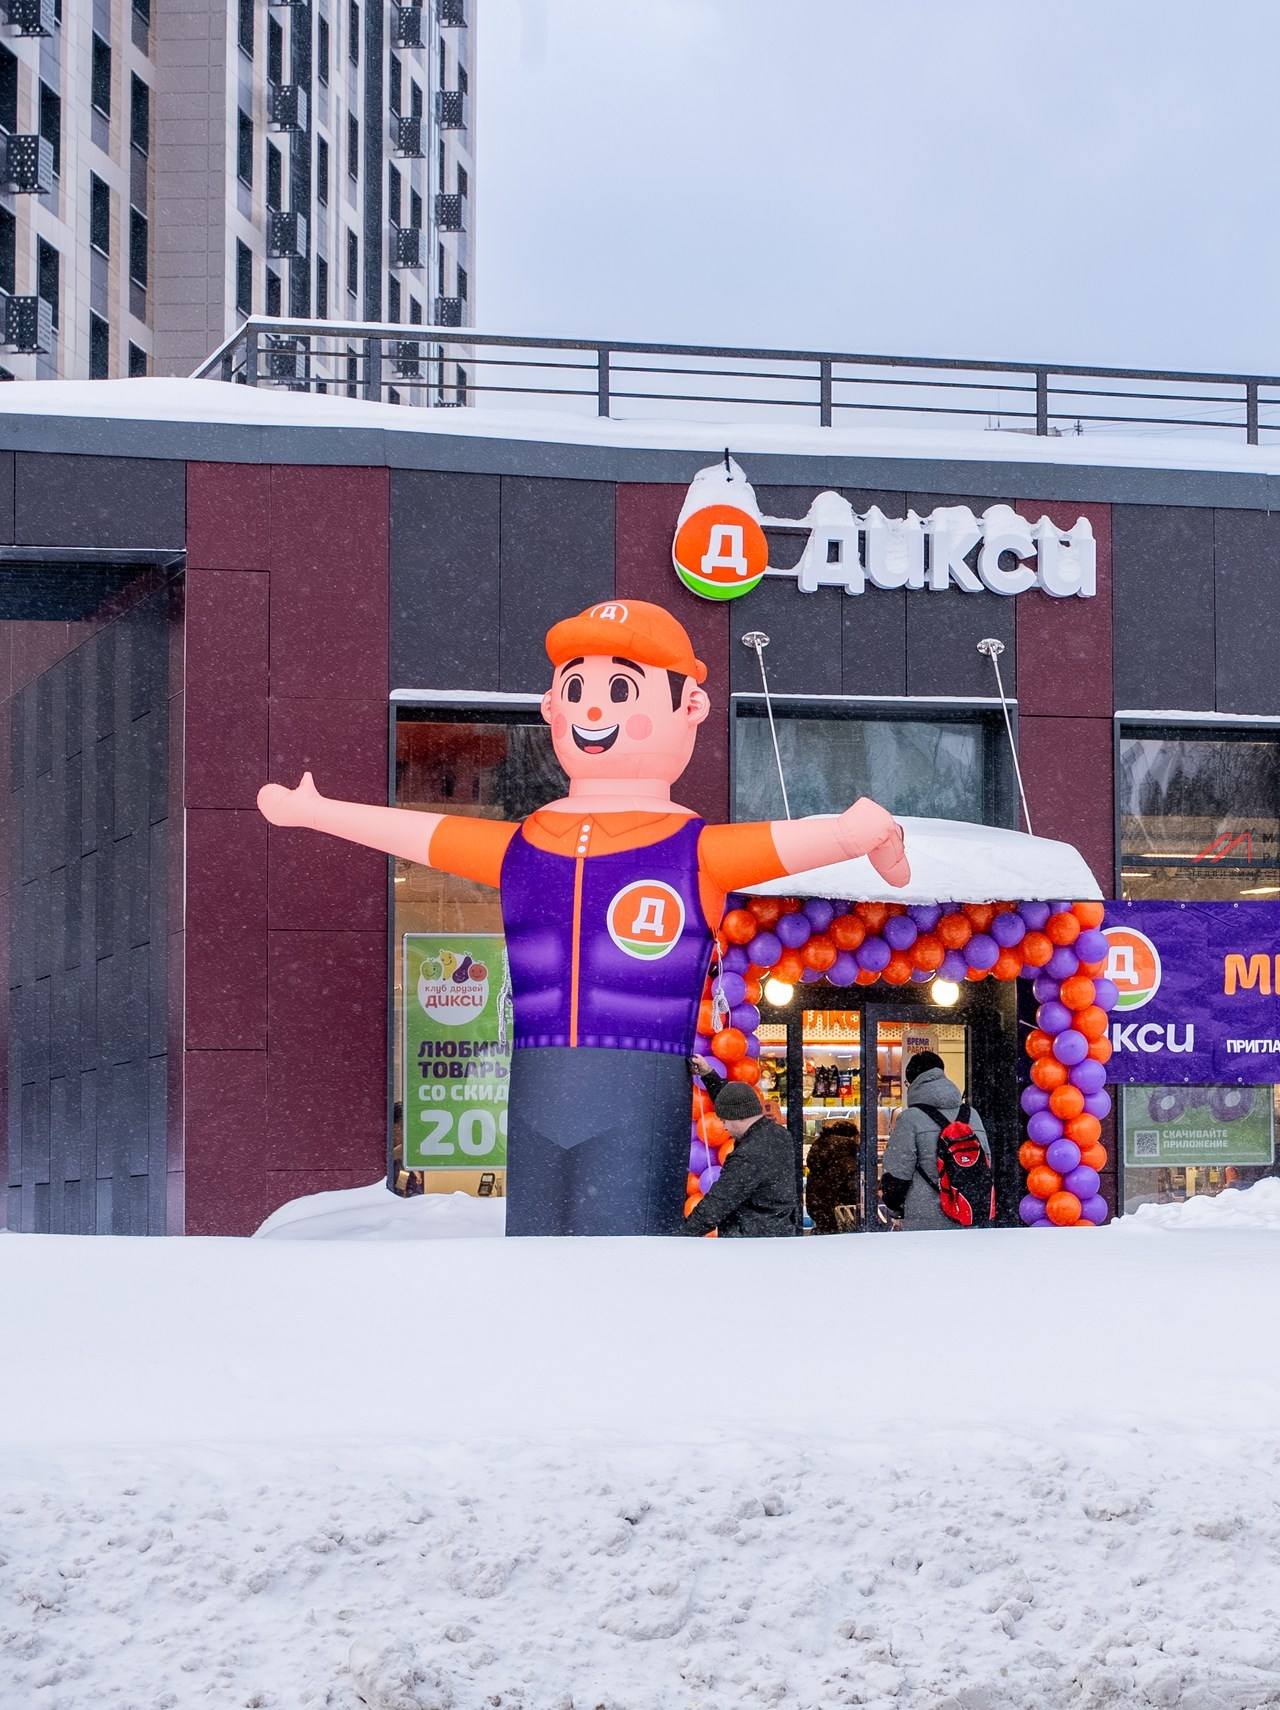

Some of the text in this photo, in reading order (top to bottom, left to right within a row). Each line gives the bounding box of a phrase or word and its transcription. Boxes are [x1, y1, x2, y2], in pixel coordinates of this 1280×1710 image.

[631, 897, 665, 937] Д
[425, 983, 483, 994] клуб друзей
[907, 1037, 930, 1046] ВРЕМЯ
[418, 1084, 446, 1102] СО
[1163, 1128, 1228, 1139] СКАЧИВАЙТЕ
[1163, 1139, 1229, 1149] ПРИЛОЖЕНИЕ
